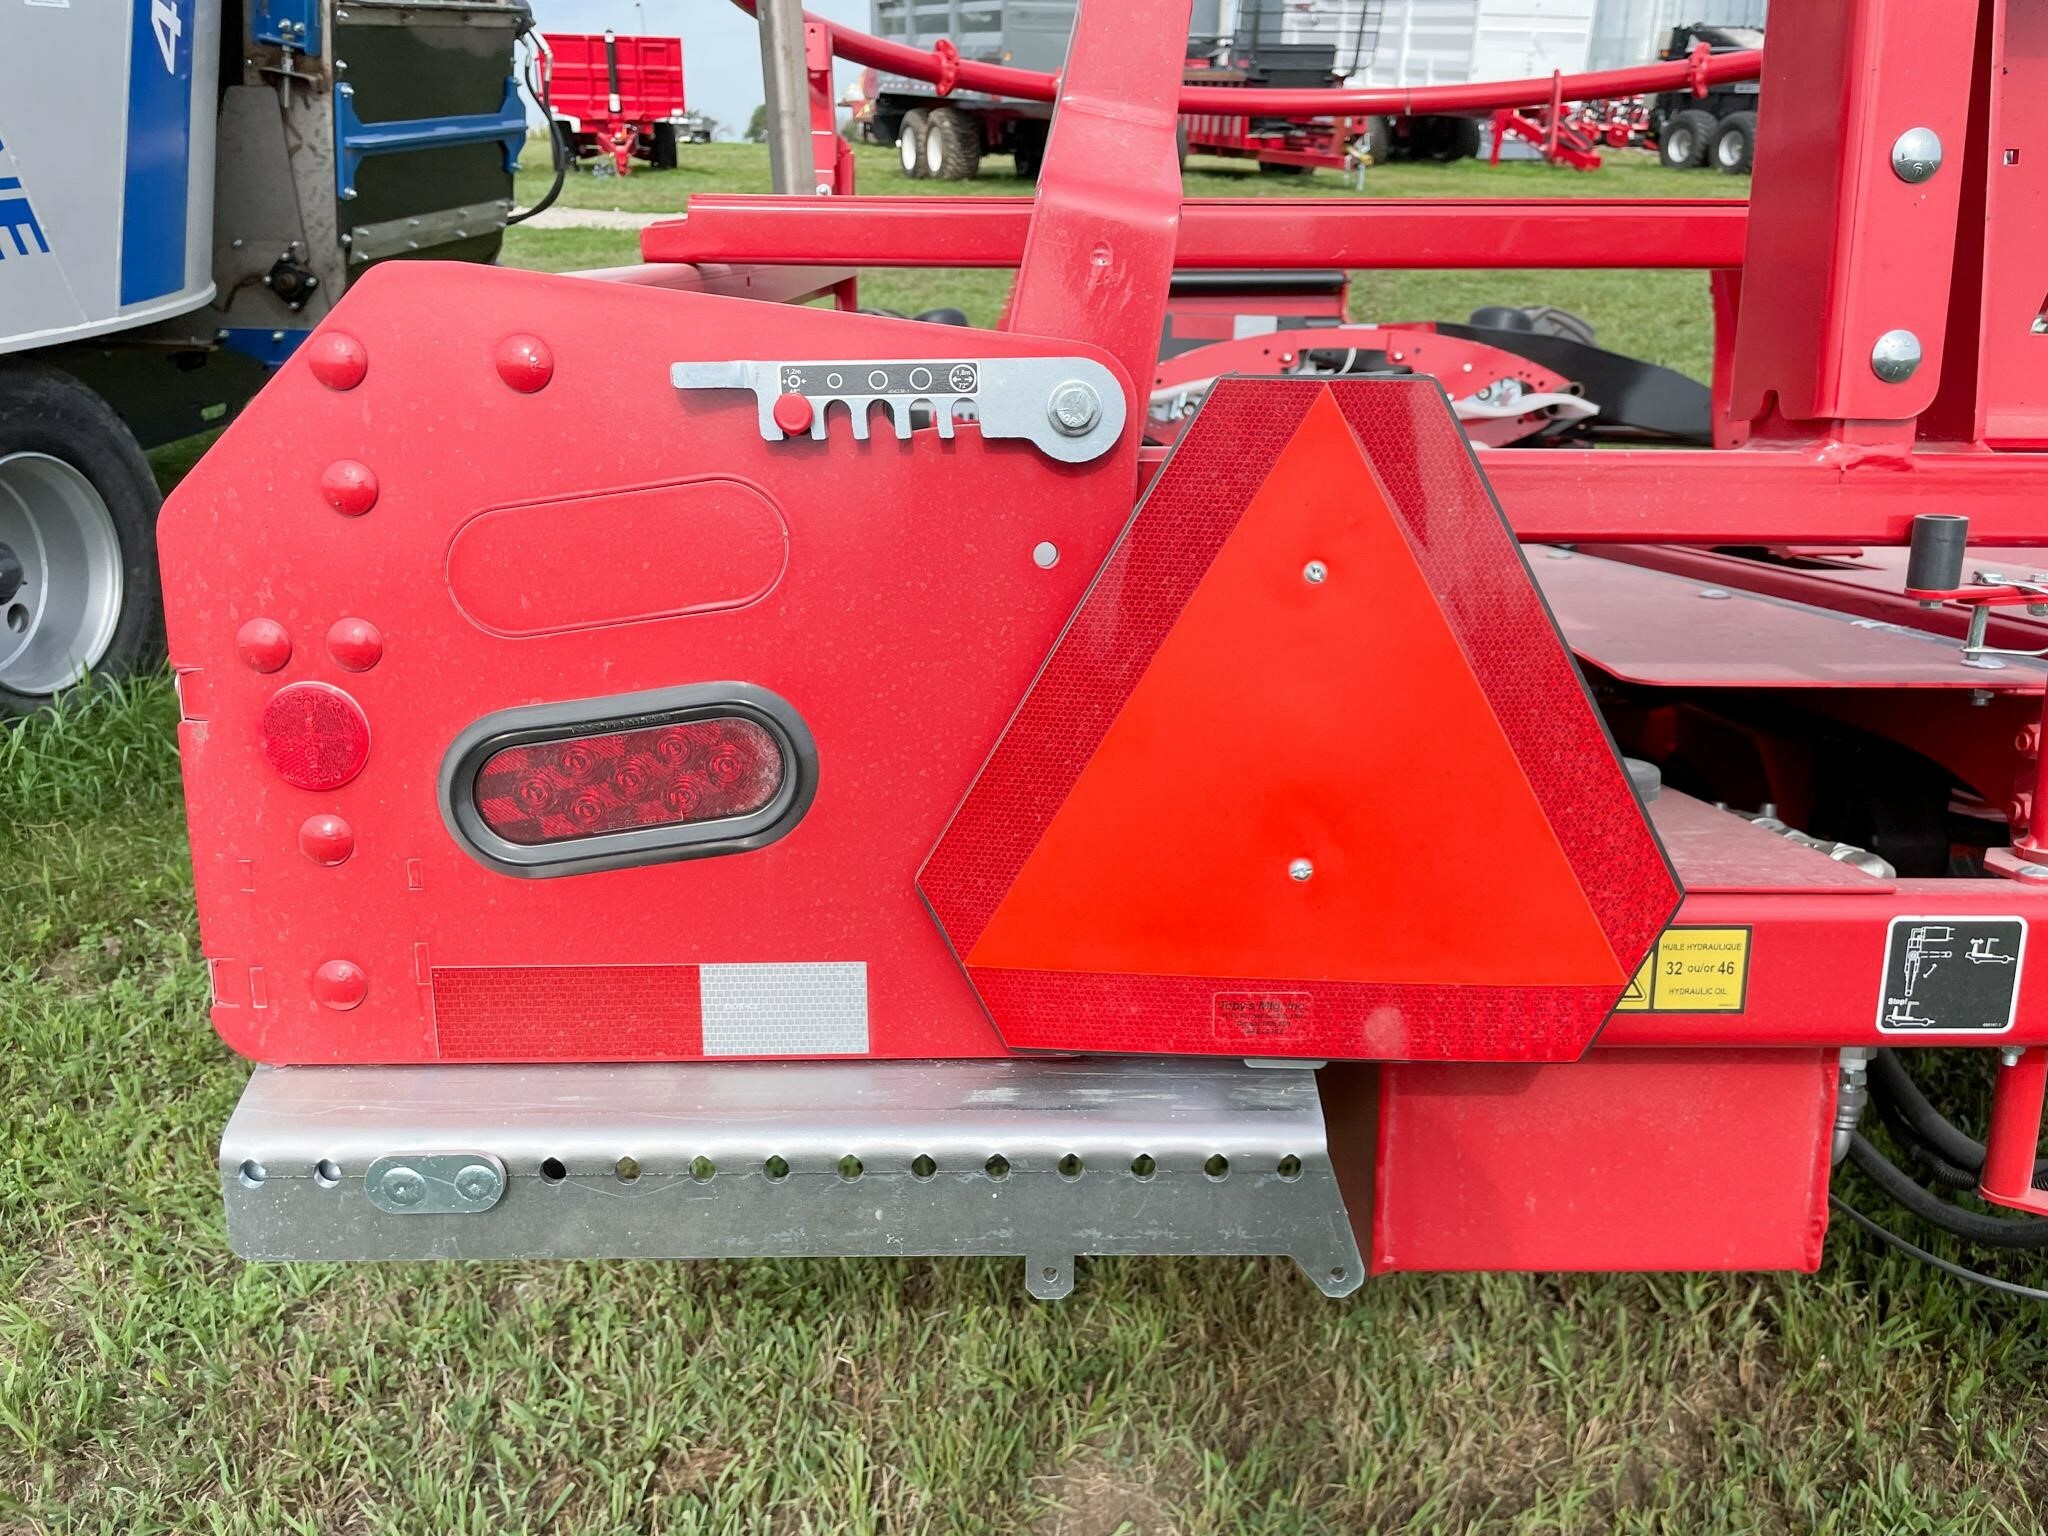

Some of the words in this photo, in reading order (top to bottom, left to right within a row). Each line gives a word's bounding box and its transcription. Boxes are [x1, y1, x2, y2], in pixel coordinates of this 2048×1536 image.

[151, 0, 182, 76] 4
[1662, 943, 1685, 951] HUILE
[1686, 943, 1743, 951] HYDRAULIQUE
[1665, 961, 1683, 975] 32
[1687, 963, 1715, 973] ou/or
[1717, 961, 1735, 975] 46
[1887, 997, 1909, 1006] Stop!
